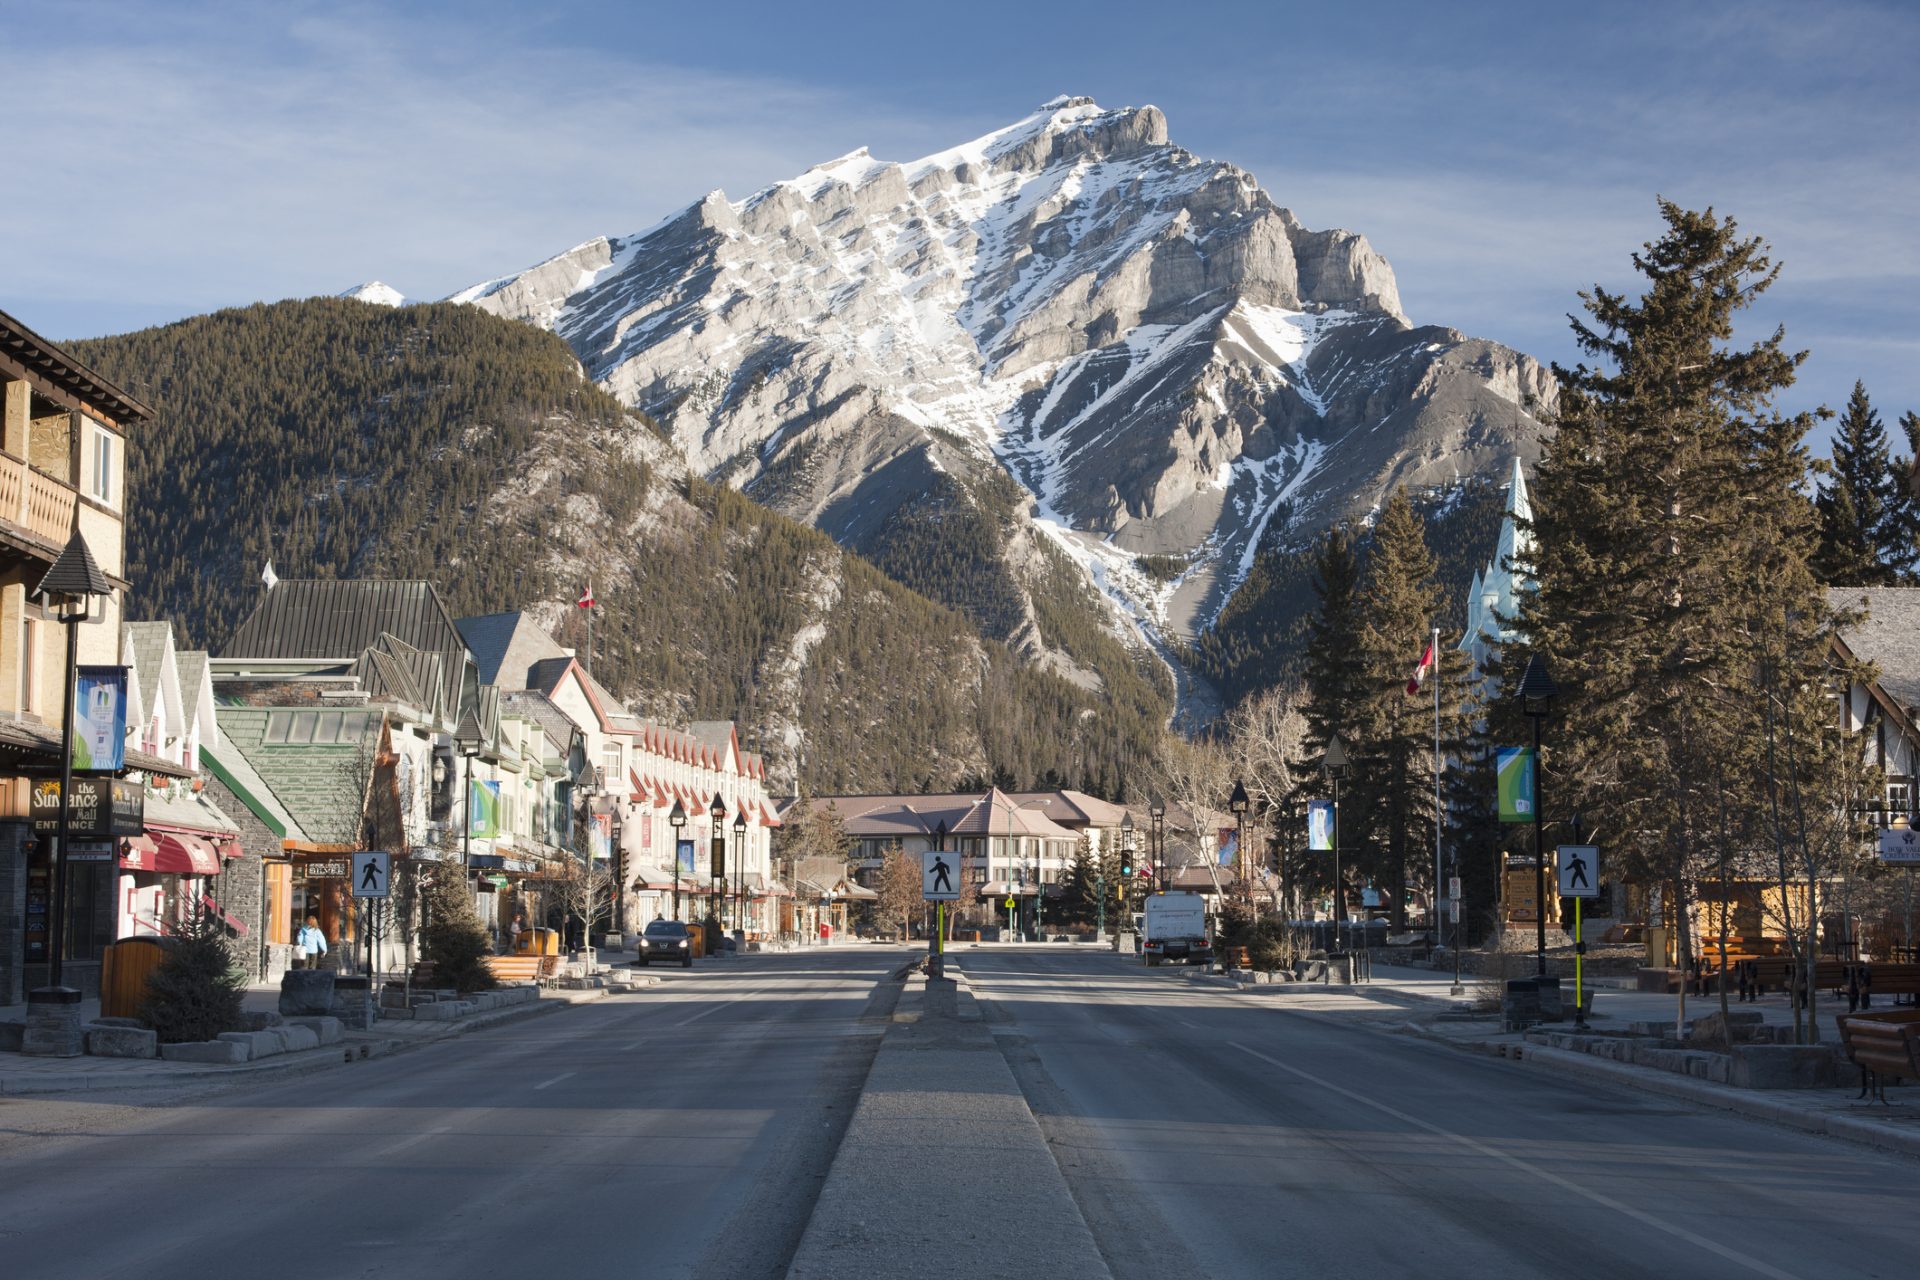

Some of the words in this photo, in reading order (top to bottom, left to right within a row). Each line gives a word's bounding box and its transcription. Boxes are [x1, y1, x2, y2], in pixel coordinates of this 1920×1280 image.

[78, 782, 95, 793] the
[33, 788, 98, 808] Sunance
[76, 808, 96, 820] Mall
